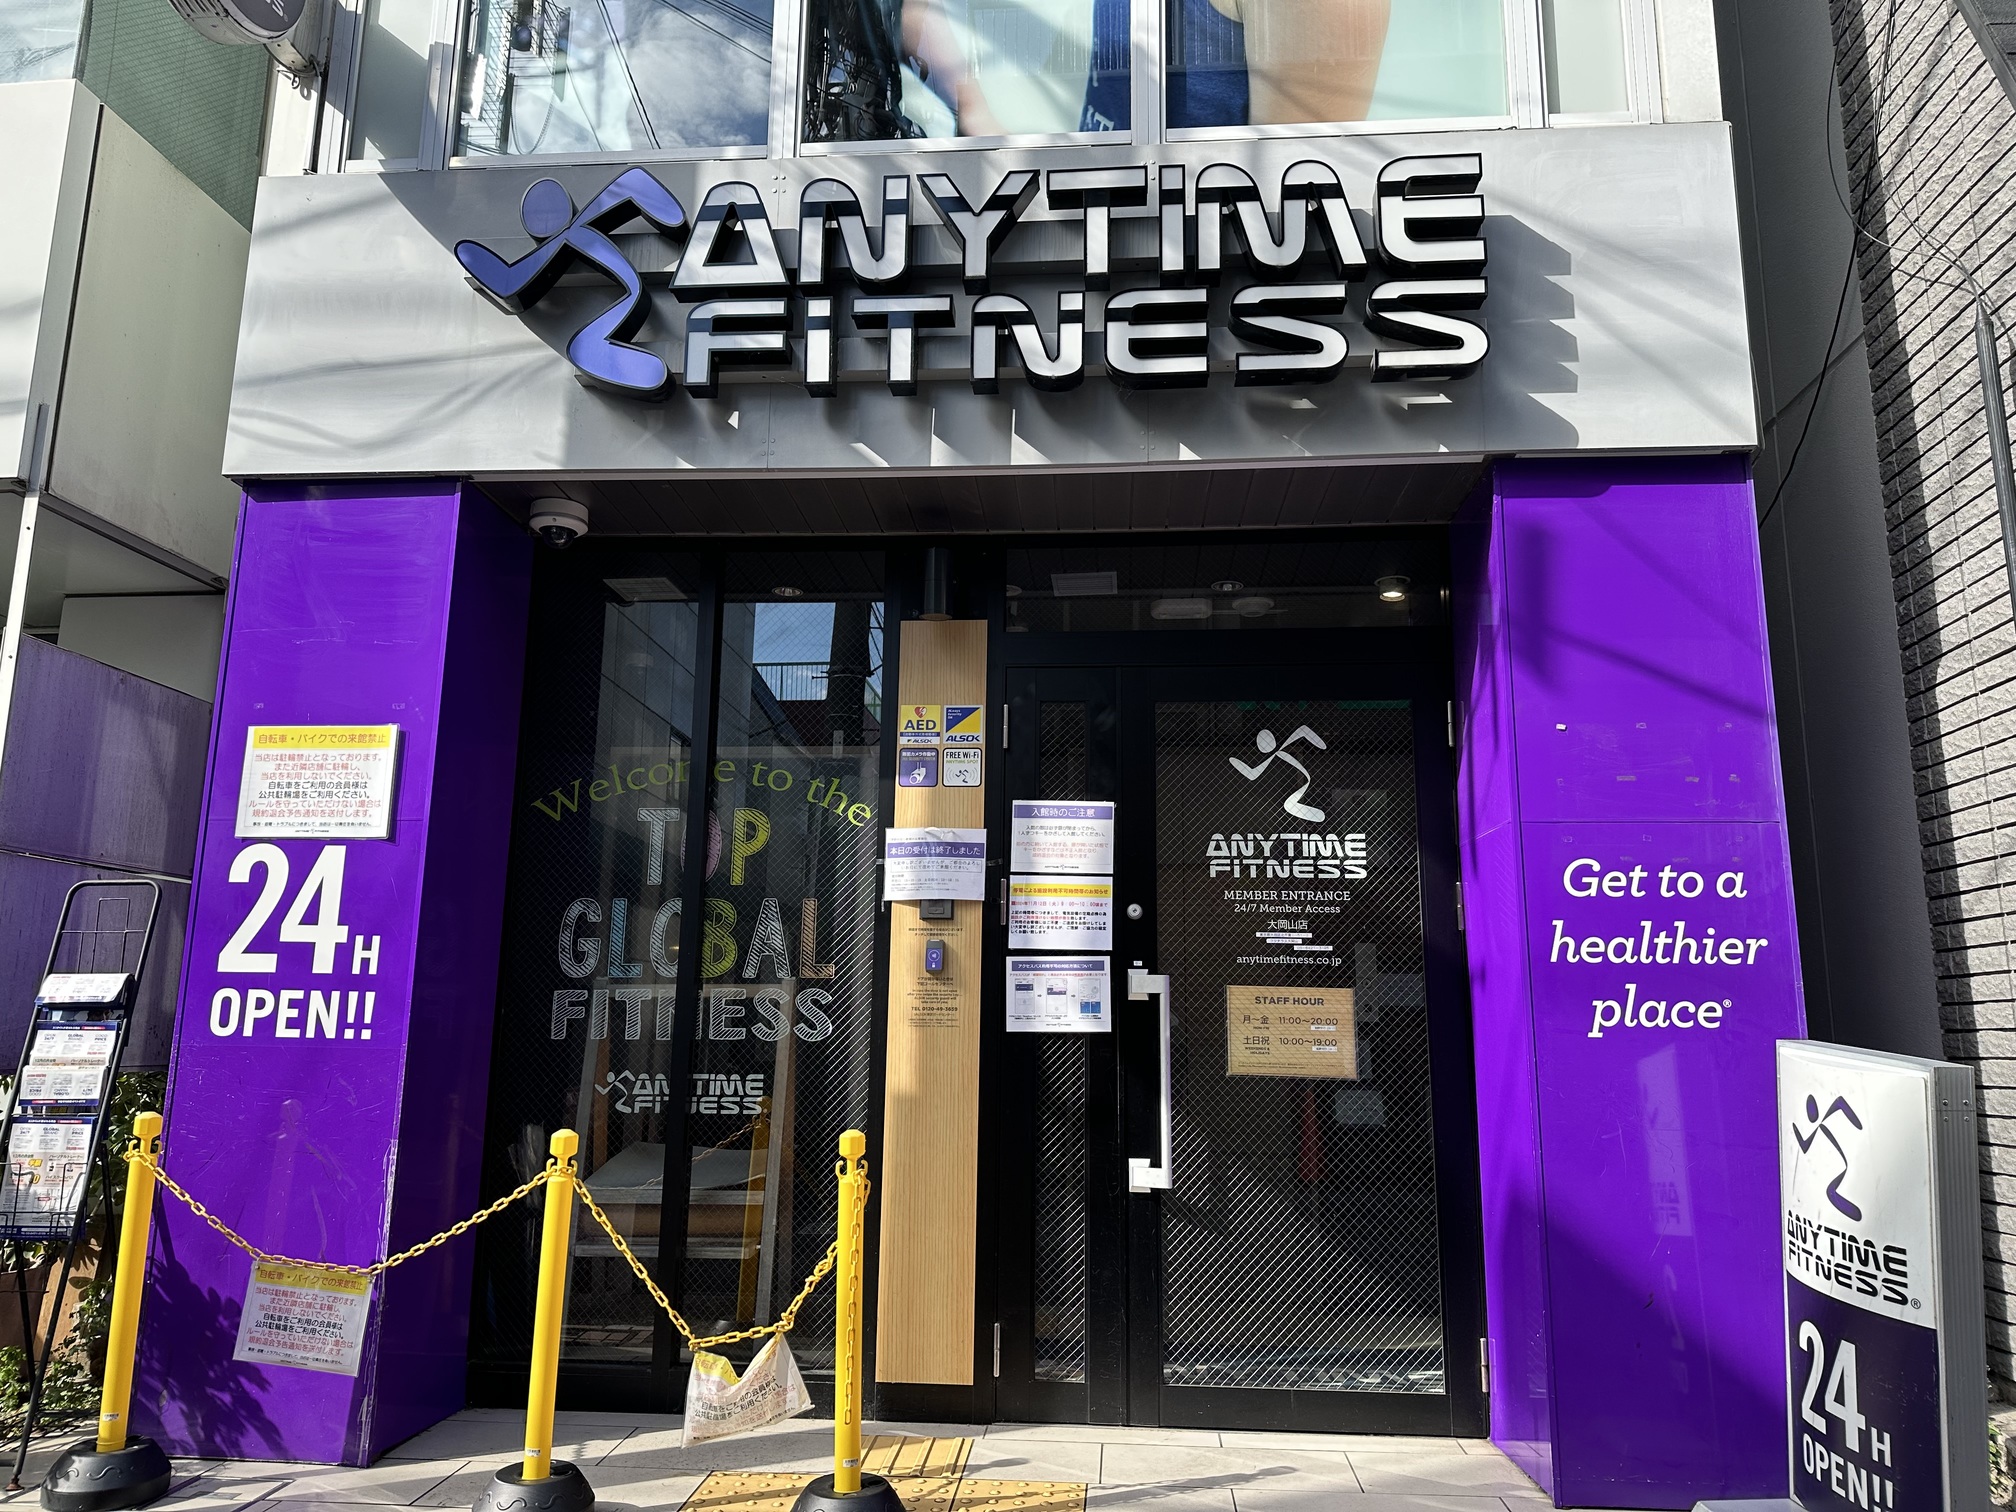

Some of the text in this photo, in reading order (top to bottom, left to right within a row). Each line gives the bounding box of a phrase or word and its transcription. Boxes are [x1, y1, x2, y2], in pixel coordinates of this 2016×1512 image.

[669, 153, 1488, 292] ANYTIME
[683, 277, 1491, 394] FITNESS
[904, 720, 936, 730] AED
[258, 734, 386, 744] 自転車・バイクでの来館禁止
[254, 754, 382, 762] 当店は駐輪禁止となっております。
[261, 772, 372, 780] 当店を利用しないでください。
[268, 781, 368, 790] 自転車をご利用の会員様は
[258, 790, 371, 799] 公共駐輪場をご利用ください。
[752, 762, 793, 792] to
[806, 778, 872, 827] the
[249, 800, 382, 808] ルールを守っていただけない場合は
[1032, 808, 1095, 817] 入館時のご注意
[890, 845, 980, 856] 本日の受付は終了しました
[1206, 834, 1367, 857] ANYTIME
[1210, 859, 1367, 879] FITNESS
[1564, 858, 1748, 898] Get to a
[1224, 890, 1350, 900] MEMBER ENTRANCE
[1234, 904, 1340, 913] 24/7 Member Access
[1268, 920, 1308, 930] 大岡山店
[558, 898, 835, 979] GLOBAL
[1550, 920, 1768, 964] healthier
[1236, 956, 1342, 966] anytimefitness.co.jp
[1255, 996, 1324, 1006] STAFF HOUR
[210, 987, 376, 1040] OPEN!!
[1243, 1036, 1270, 1045] 土日祝
[632, 1073, 764, 1096] ANTIME
[1788, 1210, 1908, 1278] ANYTIME
[260, 1269, 363, 1290] 自転車・バイクでの来館禁止
[263, 1313, 343, 1330] 自転車をご利用の会員様は
